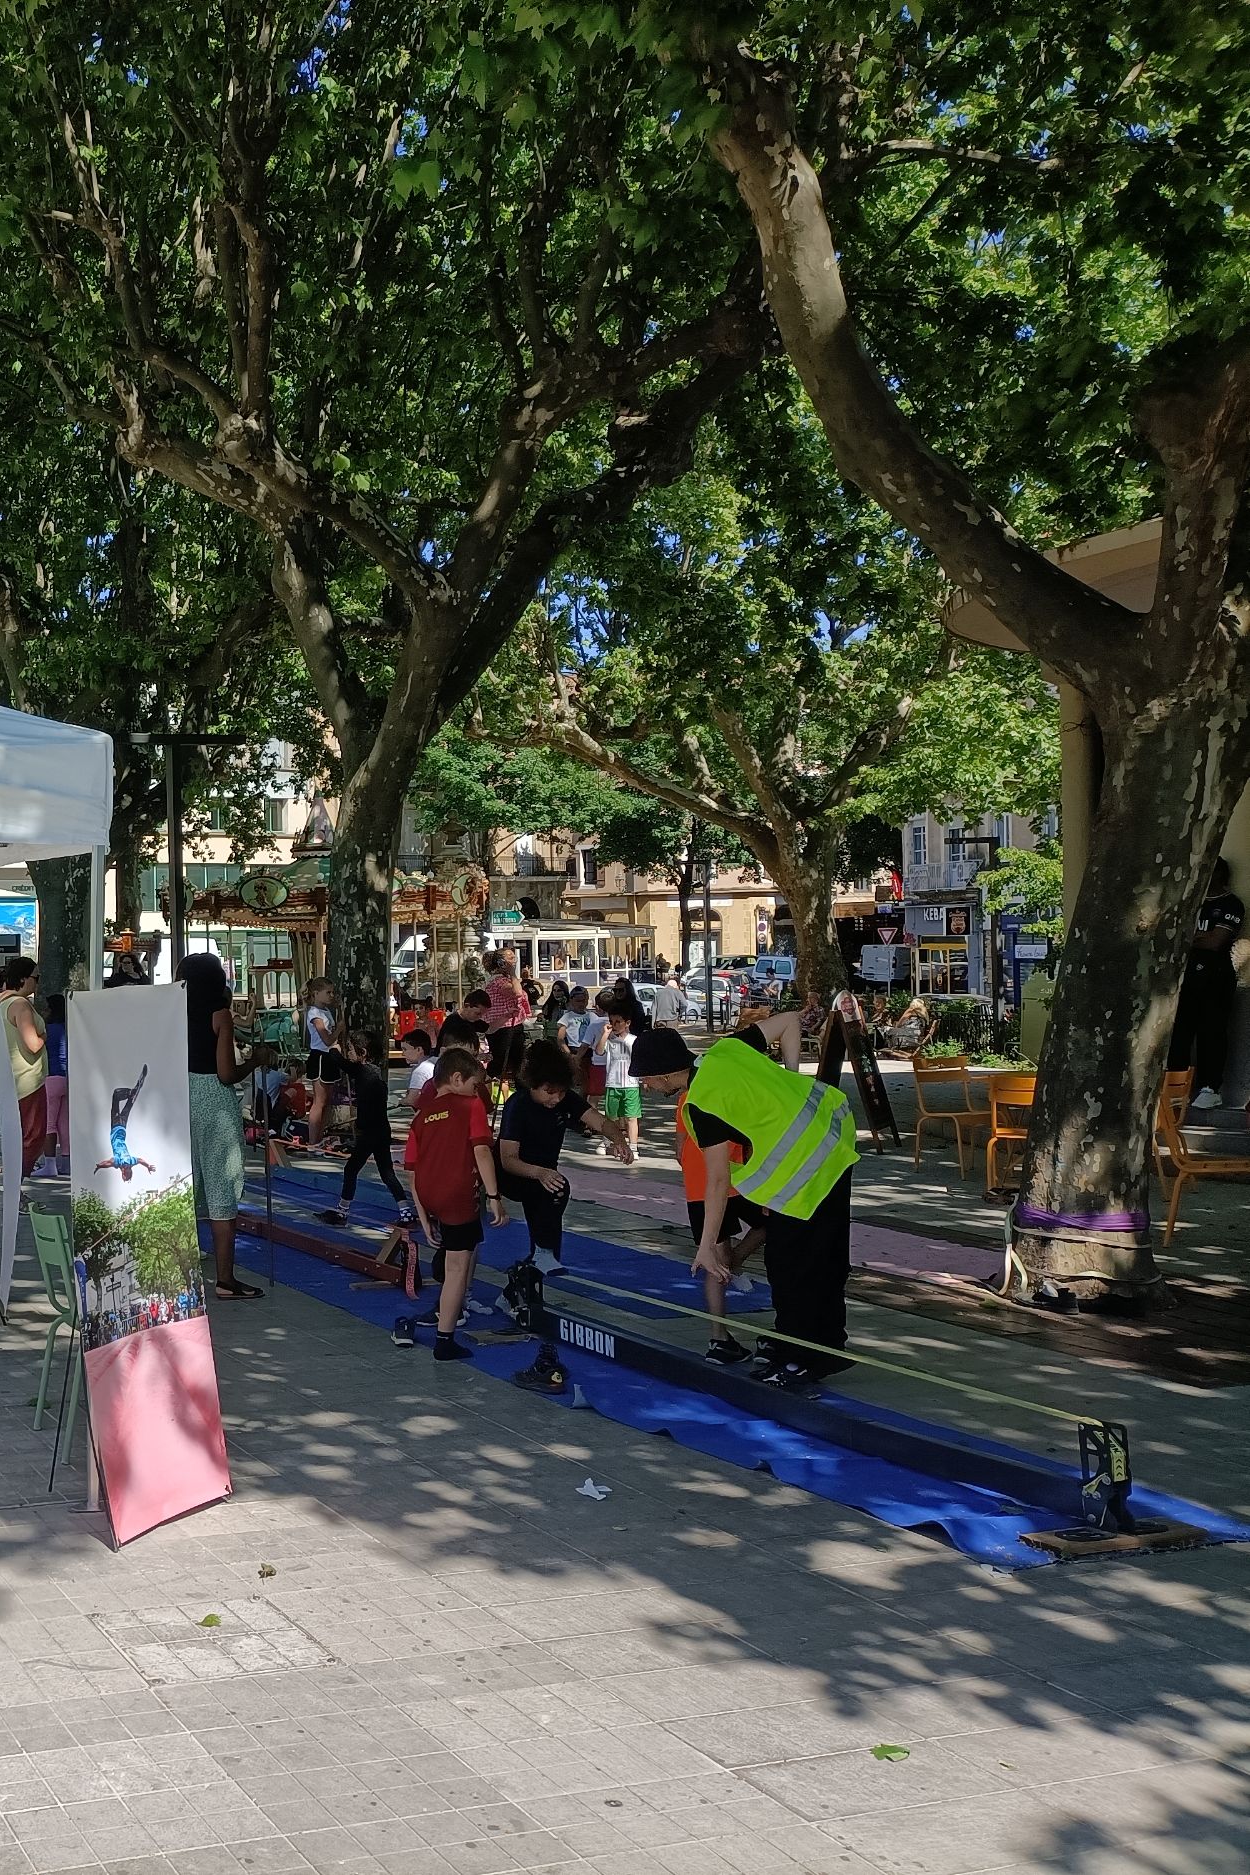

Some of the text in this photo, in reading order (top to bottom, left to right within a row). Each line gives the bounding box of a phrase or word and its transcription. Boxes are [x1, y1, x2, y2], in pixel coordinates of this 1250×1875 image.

[923, 907, 944, 921] KEBA
[424, 1110, 450, 1124] LOUIS
[560, 1318, 615, 1359] GIBBON
